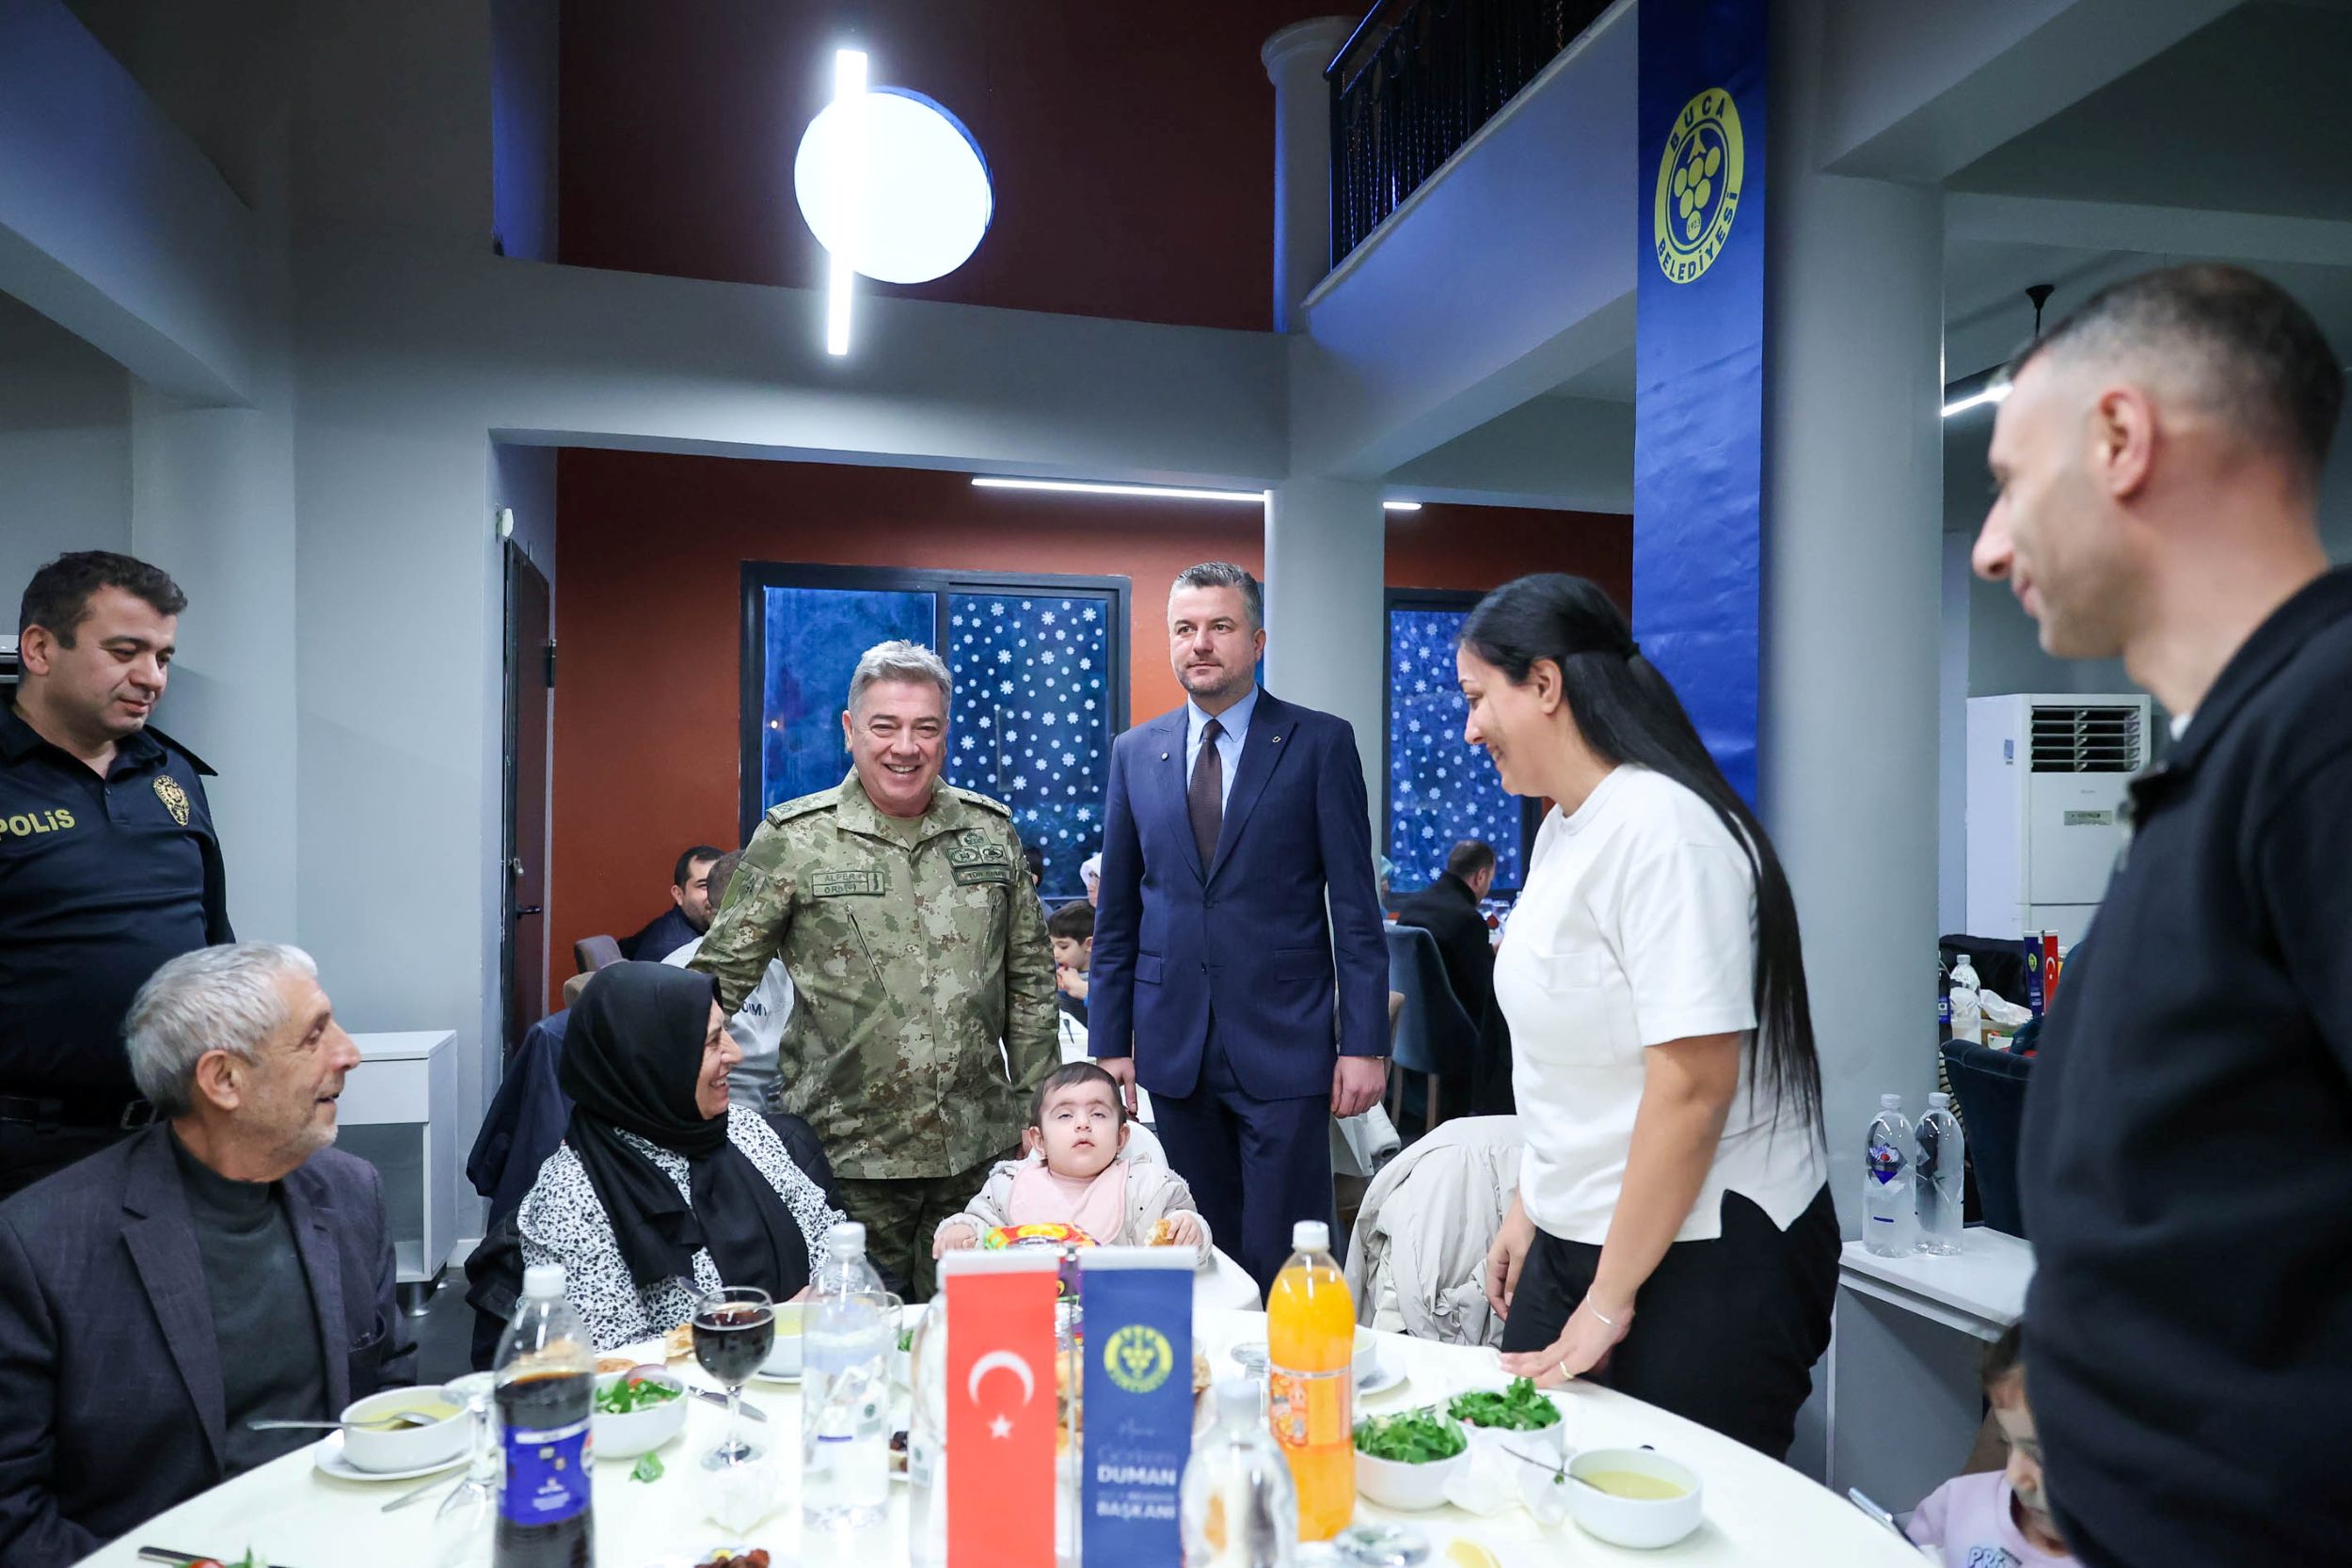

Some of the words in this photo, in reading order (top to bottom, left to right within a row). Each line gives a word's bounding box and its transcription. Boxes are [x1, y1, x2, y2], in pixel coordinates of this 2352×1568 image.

[1670, 95, 1725, 153] BUCA
[1658, 191, 1739, 280] BELEDİYESİ
[1096, 1465, 1177, 1486] DUMAN
